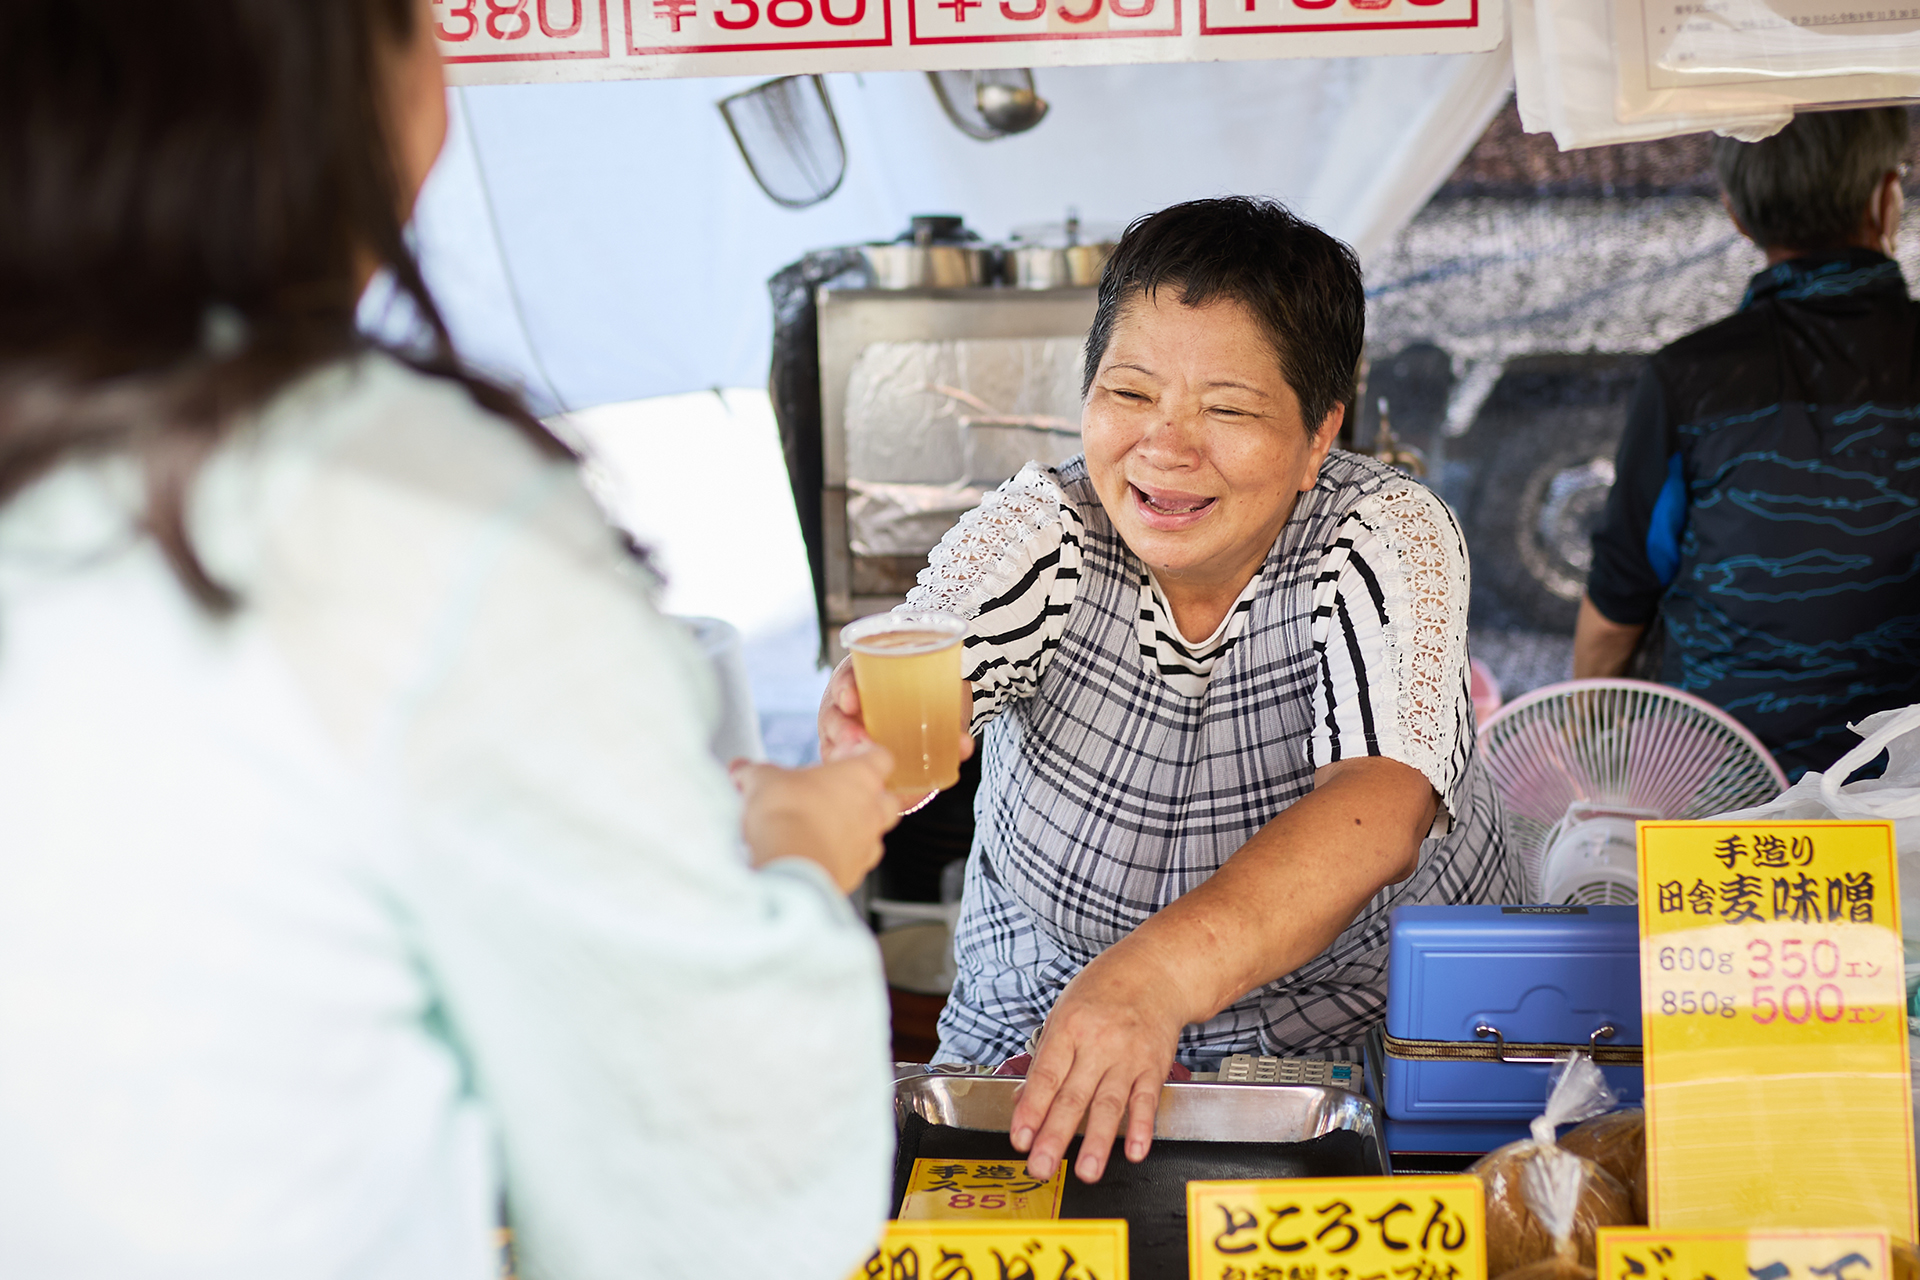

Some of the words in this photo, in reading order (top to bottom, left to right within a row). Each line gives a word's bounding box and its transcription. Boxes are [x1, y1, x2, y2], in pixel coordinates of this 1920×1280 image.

[1714, 834, 1815, 869] 手造り
[1658, 872, 1875, 925] 田舎麦味噌
[1659, 946, 1735, 975] 600g
[1661, 990, 1737, 1019] 850g
[921, 1179, 1050, 1193] スープ
[1213, 1198, 1467, 1254] ところてん
